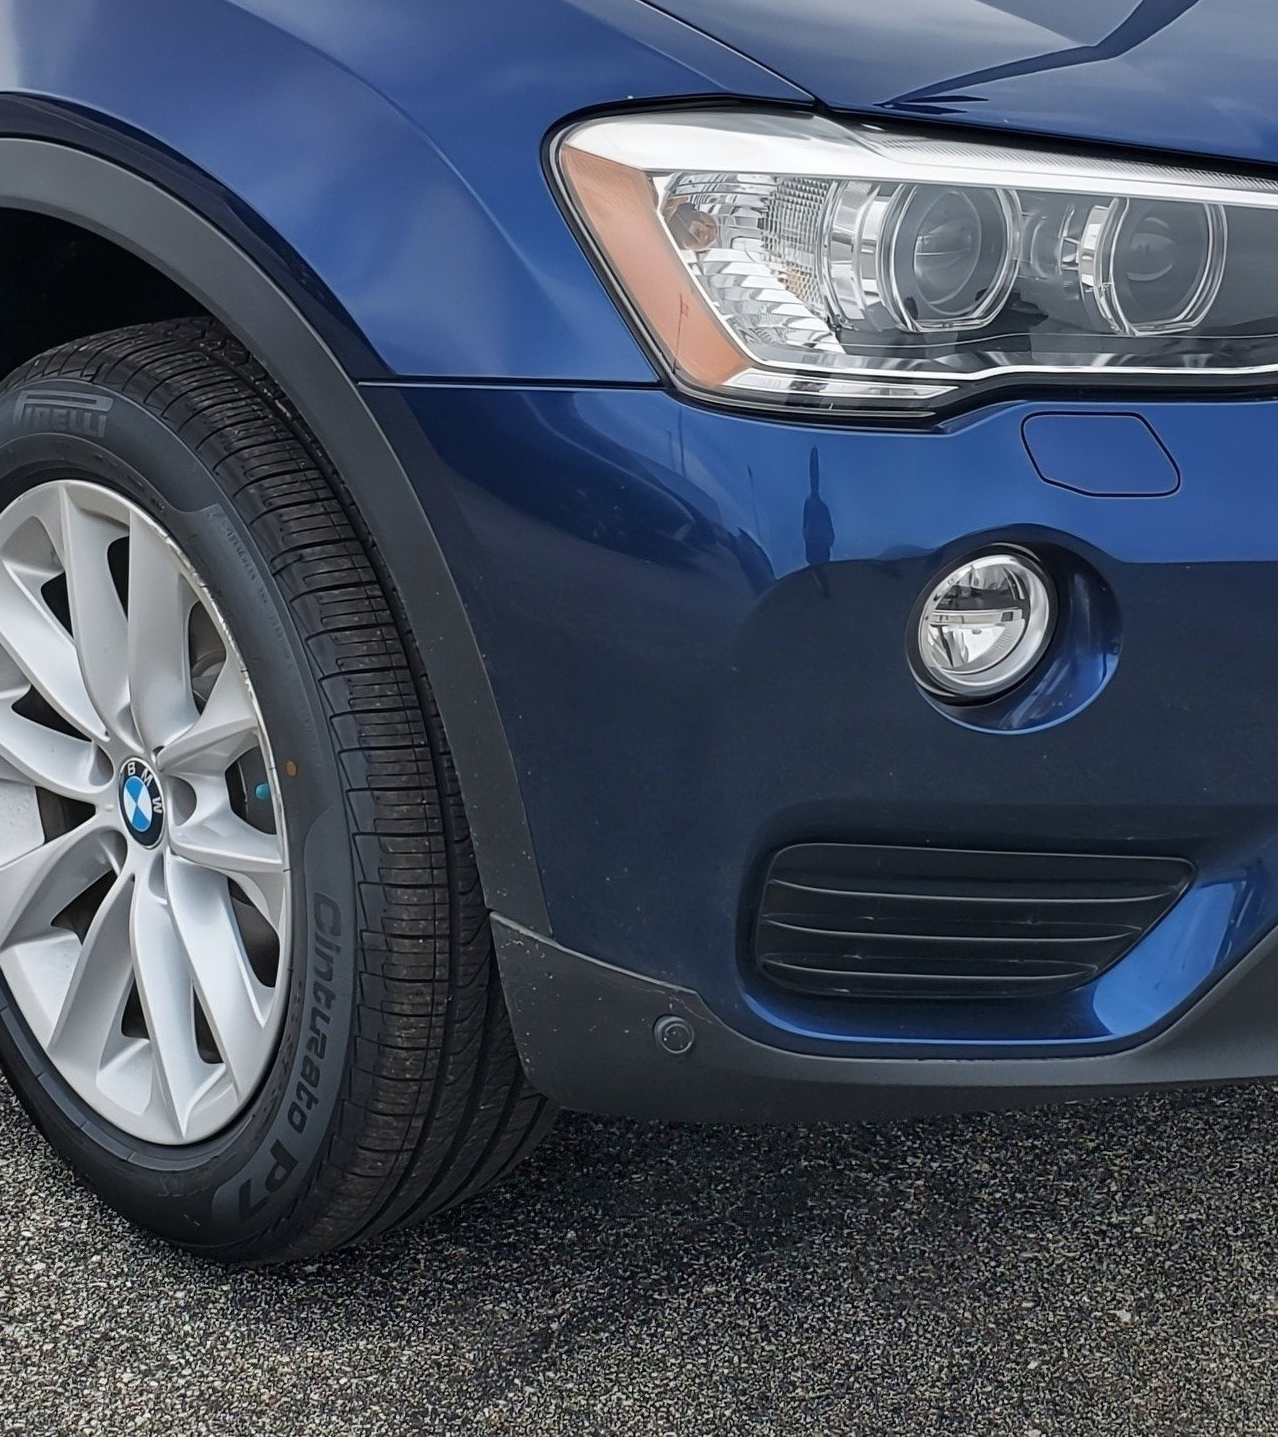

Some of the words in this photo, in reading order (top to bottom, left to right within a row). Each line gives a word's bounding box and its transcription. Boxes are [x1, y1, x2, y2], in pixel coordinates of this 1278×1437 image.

[126, 760, 164, 815] BMW
[286, 890, 344, 1135] Cinturato
[237, 1139, 303, 1221] P7
